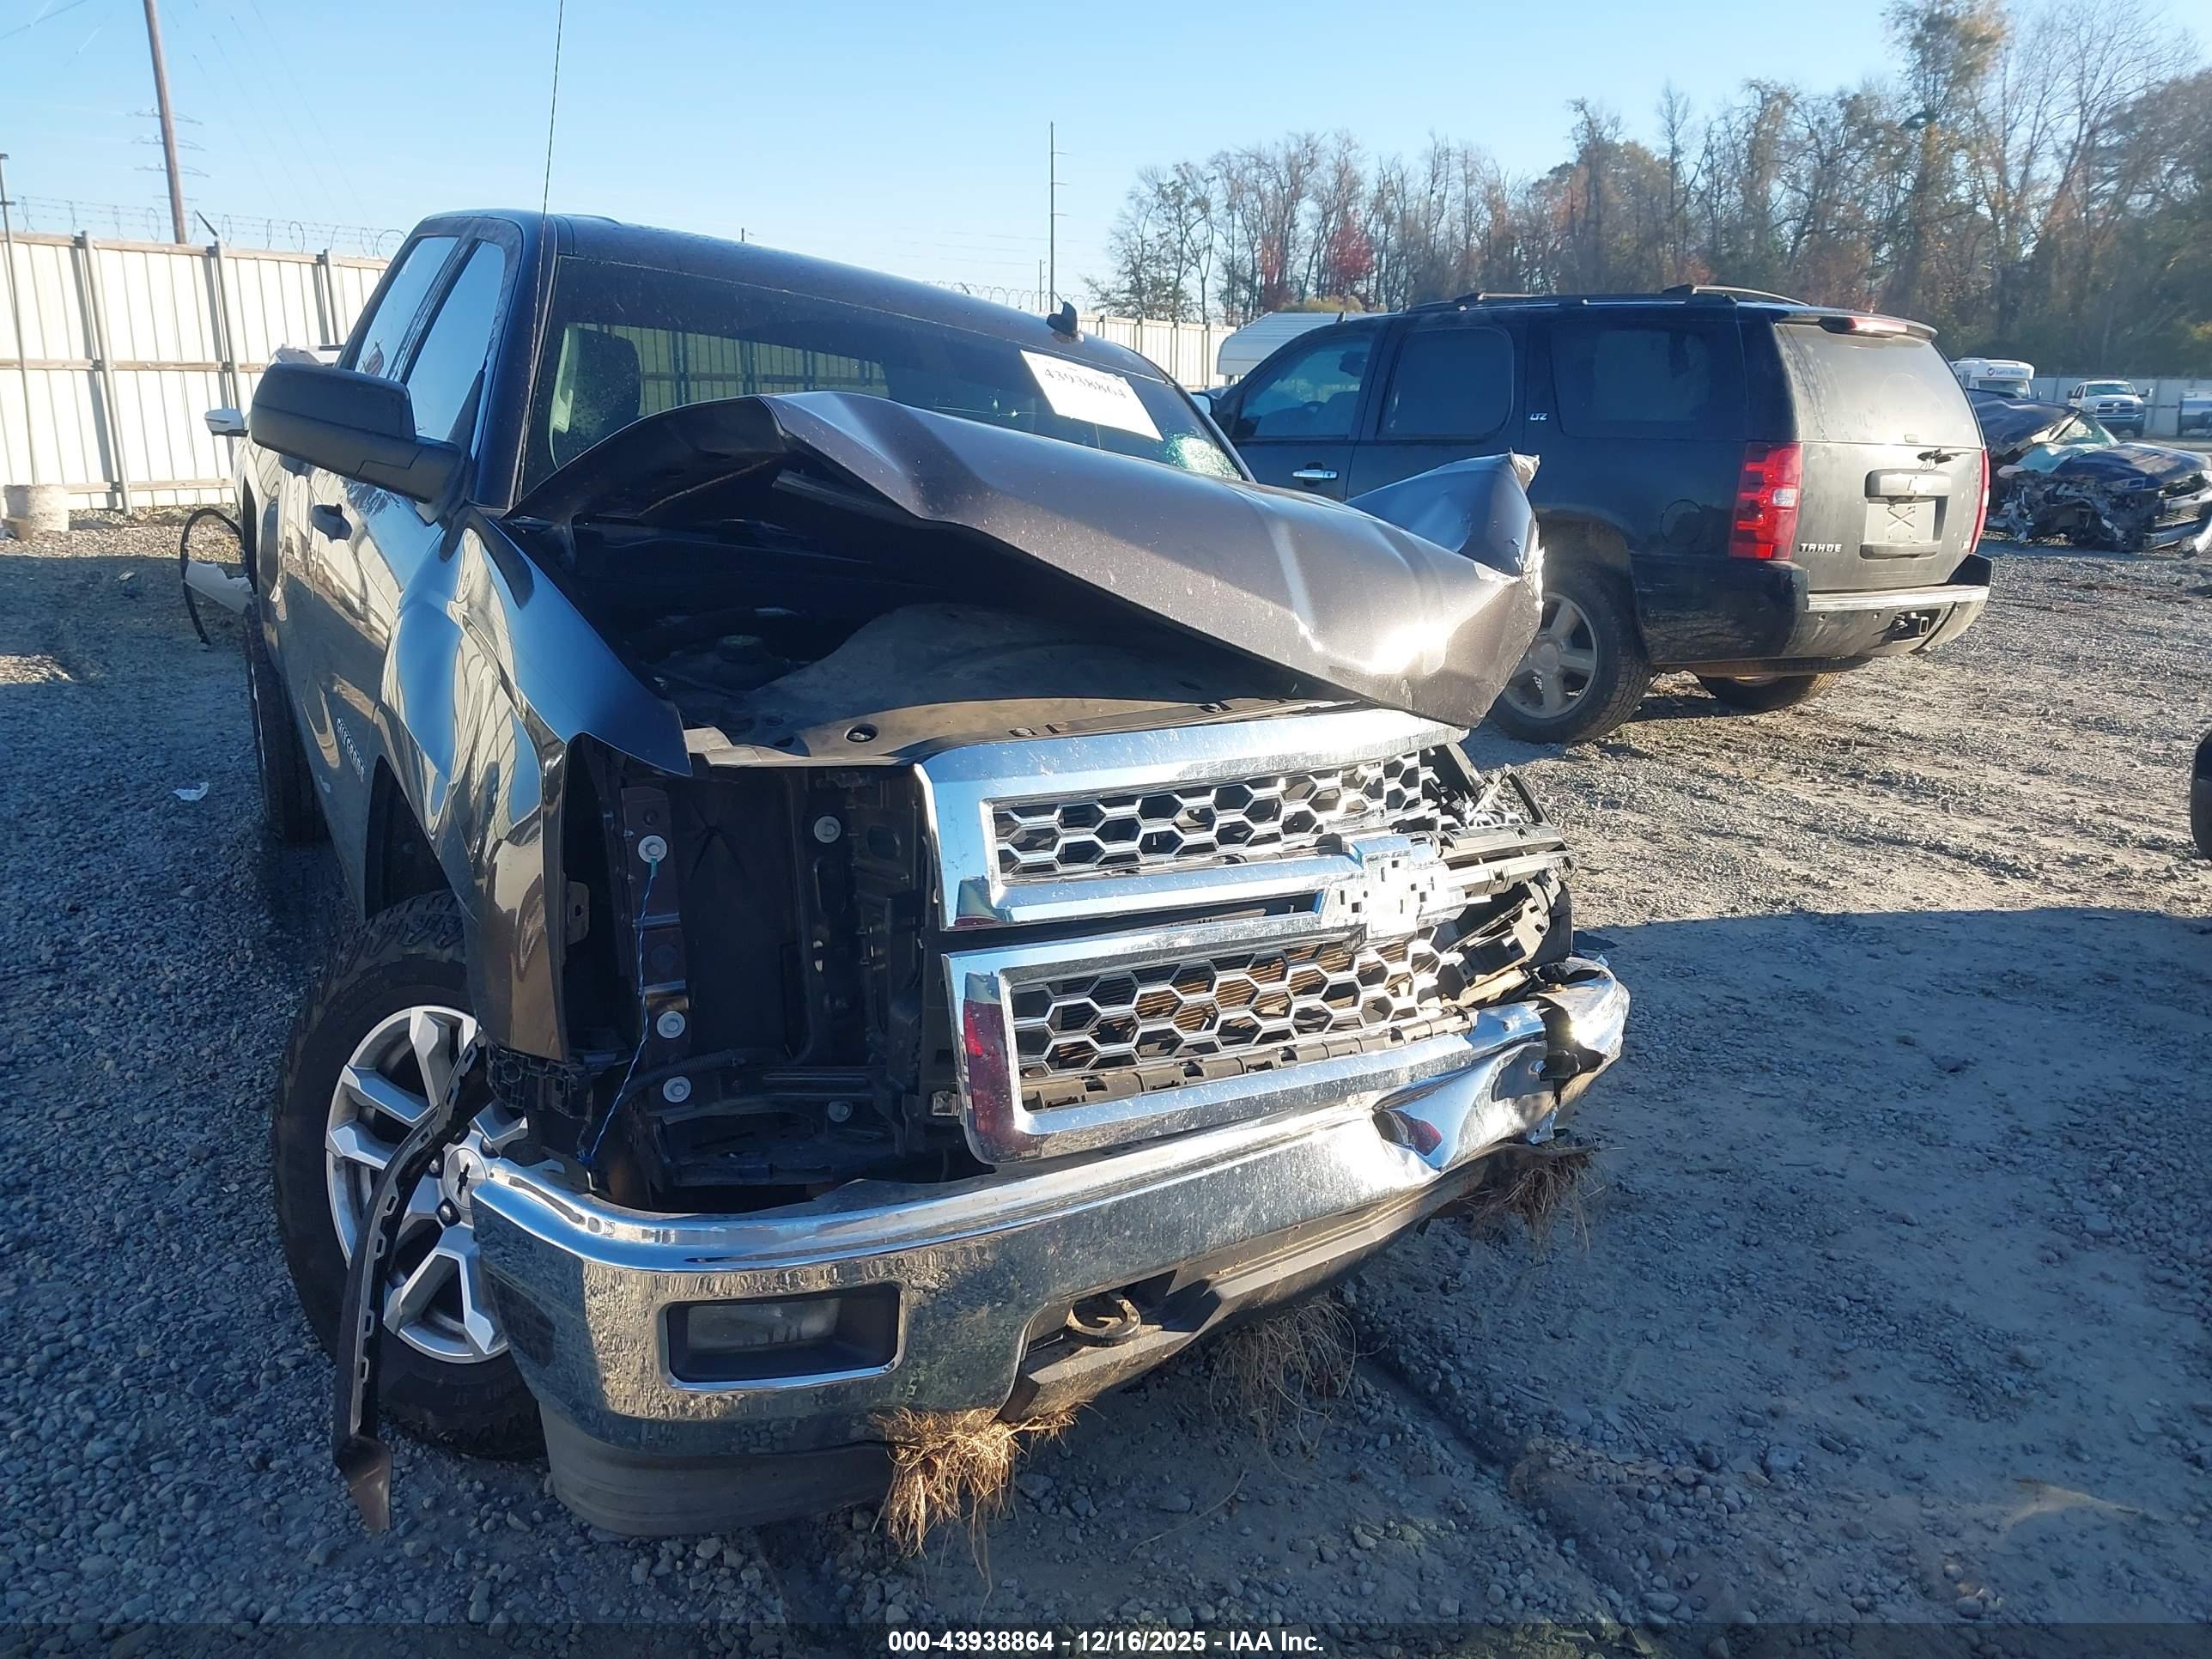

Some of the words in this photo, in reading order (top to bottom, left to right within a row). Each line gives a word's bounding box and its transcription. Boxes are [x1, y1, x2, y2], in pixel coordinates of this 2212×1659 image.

[1044, 368, 1127, 398] 43938864
[1529, 412, 1548, 421] LTZ
[1800, 543, 1843, 553] TAHOE
